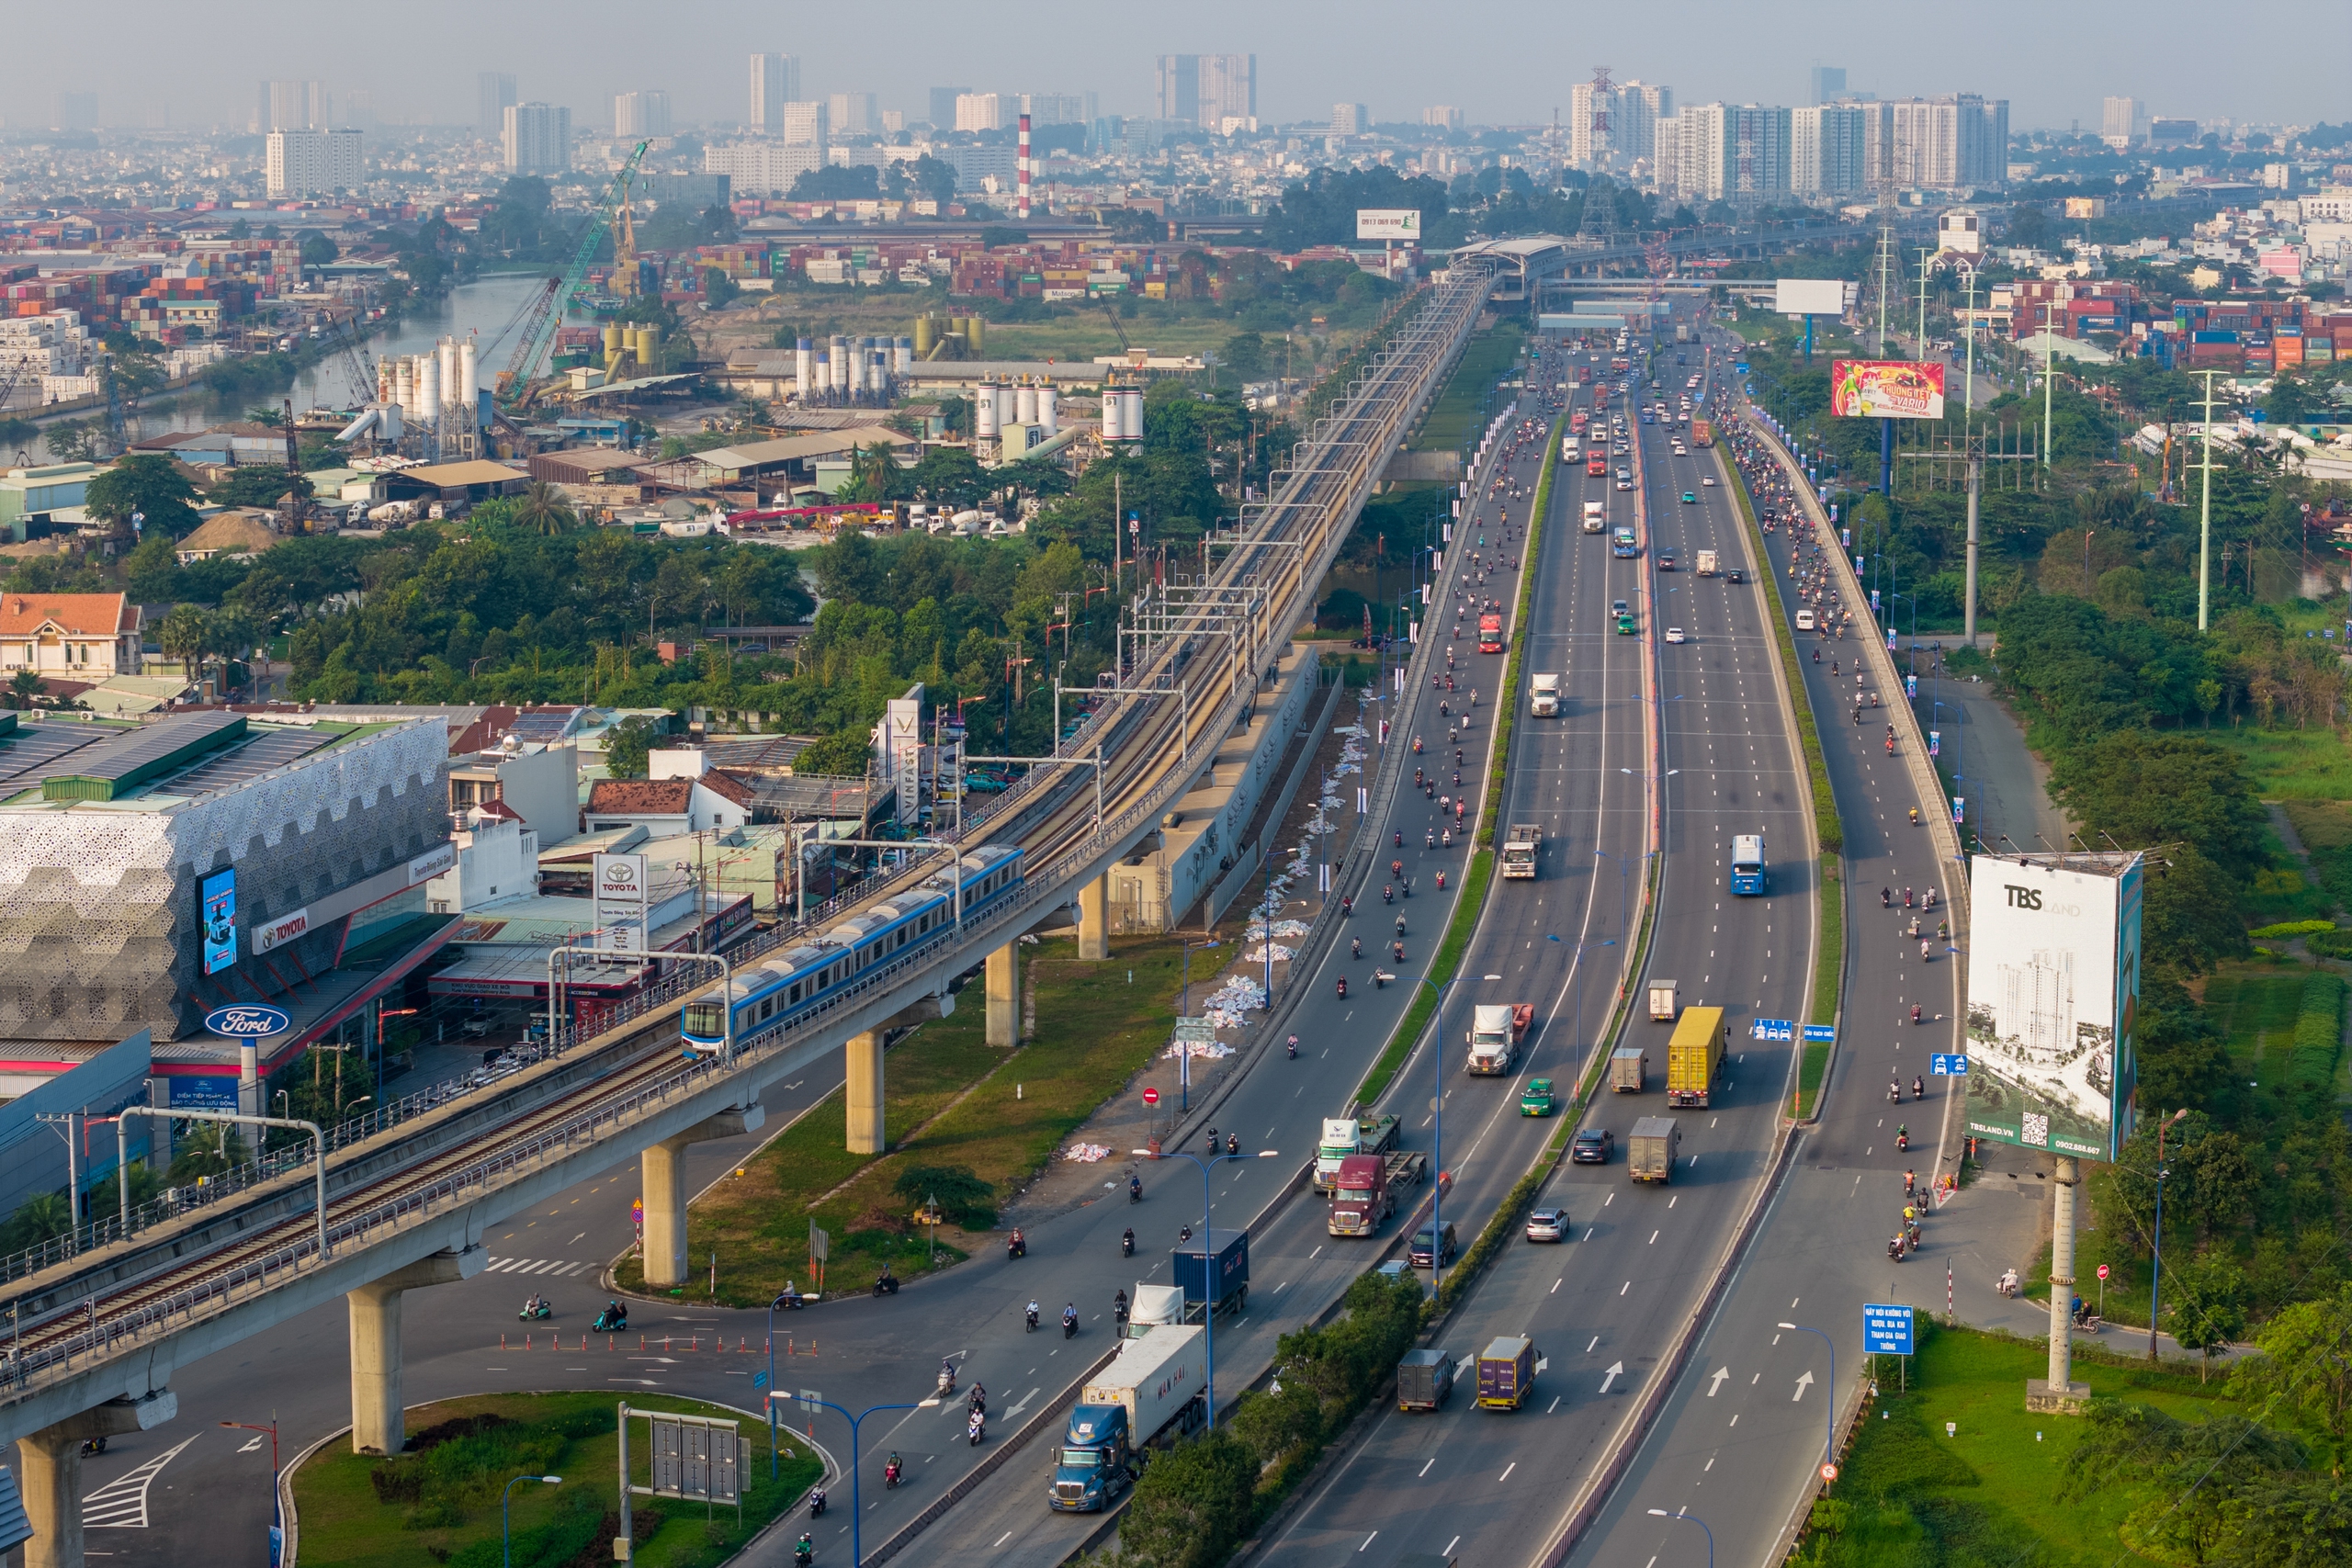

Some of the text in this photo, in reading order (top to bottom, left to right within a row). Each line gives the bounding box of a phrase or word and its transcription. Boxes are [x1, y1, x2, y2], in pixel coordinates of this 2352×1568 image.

[1897, 397, 1926, 410] VARIO
[905, 750, 914, 808] VINFAST
[603, 884, 638, 892] TOYOTA
[2004, 884, 2080, 917] TBS LAND
[276, 916, 306, 941] TOYOTA
[220, 1010, 272, 1032] Ford
[1970, 1122, 2014, 1138] TBSLAND.VN
[2054, 1139, 2100, 1156] 0902.888.667
[1158, 1364, 1185, 1401] WAN HAI
